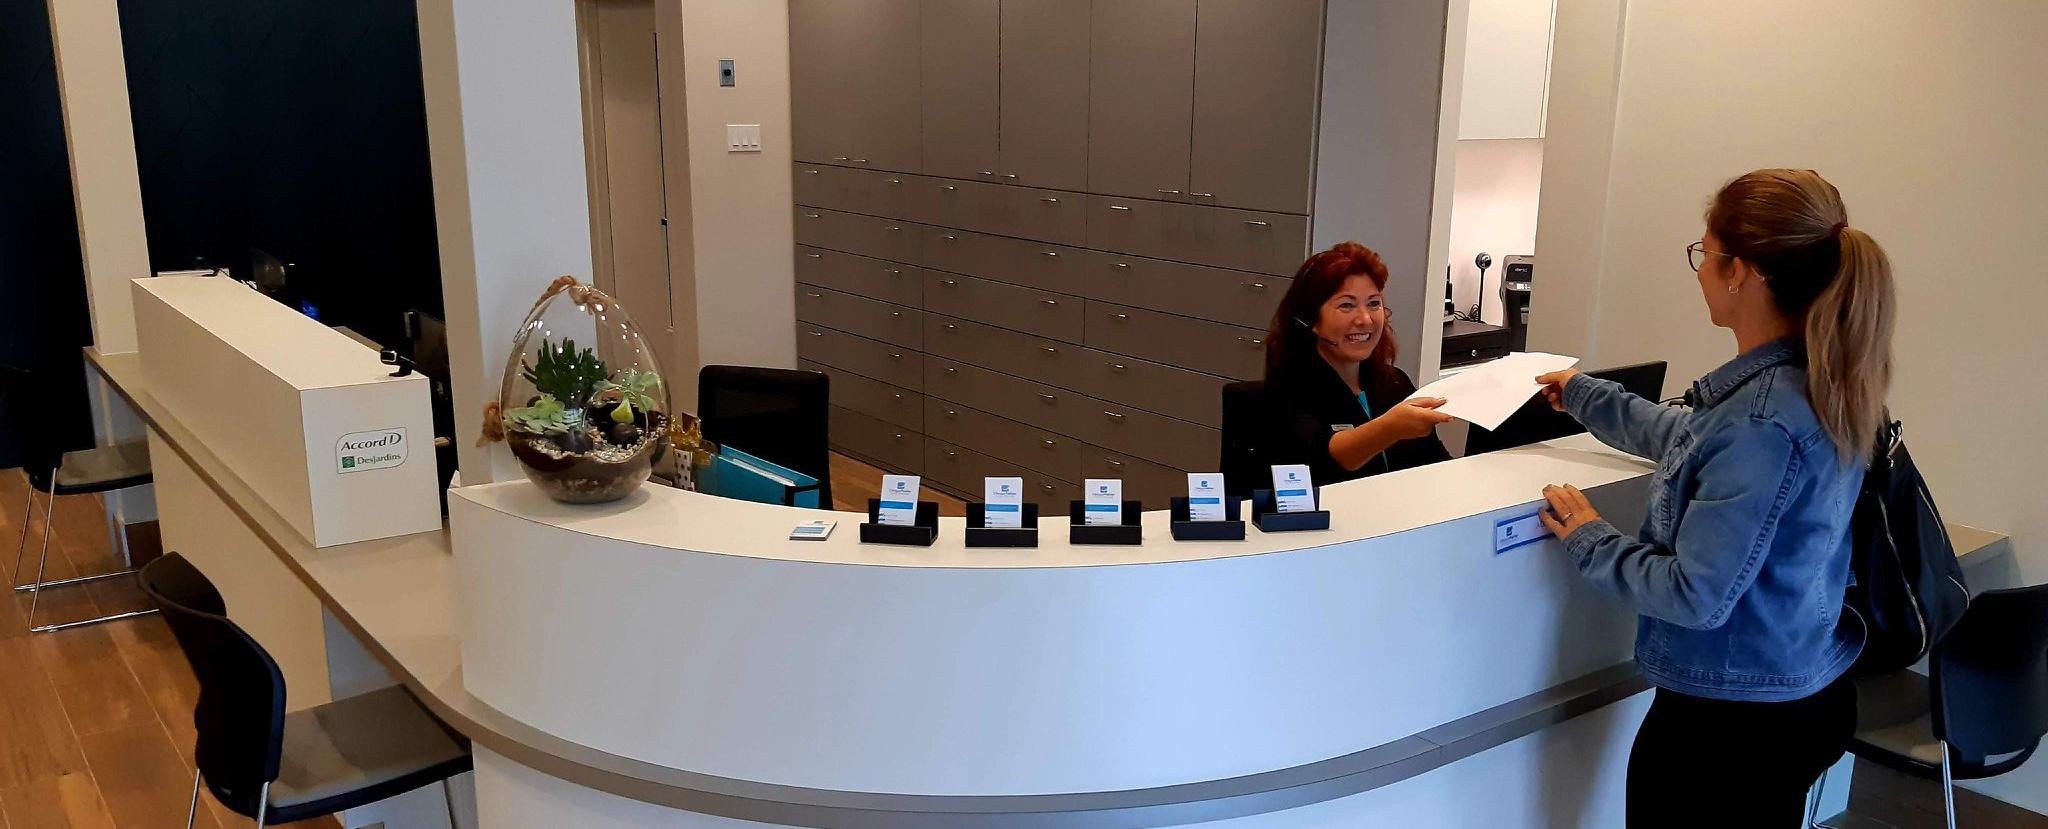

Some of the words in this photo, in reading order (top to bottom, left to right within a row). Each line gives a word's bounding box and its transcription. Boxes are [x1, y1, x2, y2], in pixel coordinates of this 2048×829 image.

[341, 436, 387, 451] Accord
[387, 432, 402, 445] D
[357, 453, 402, 465] Desjardins
